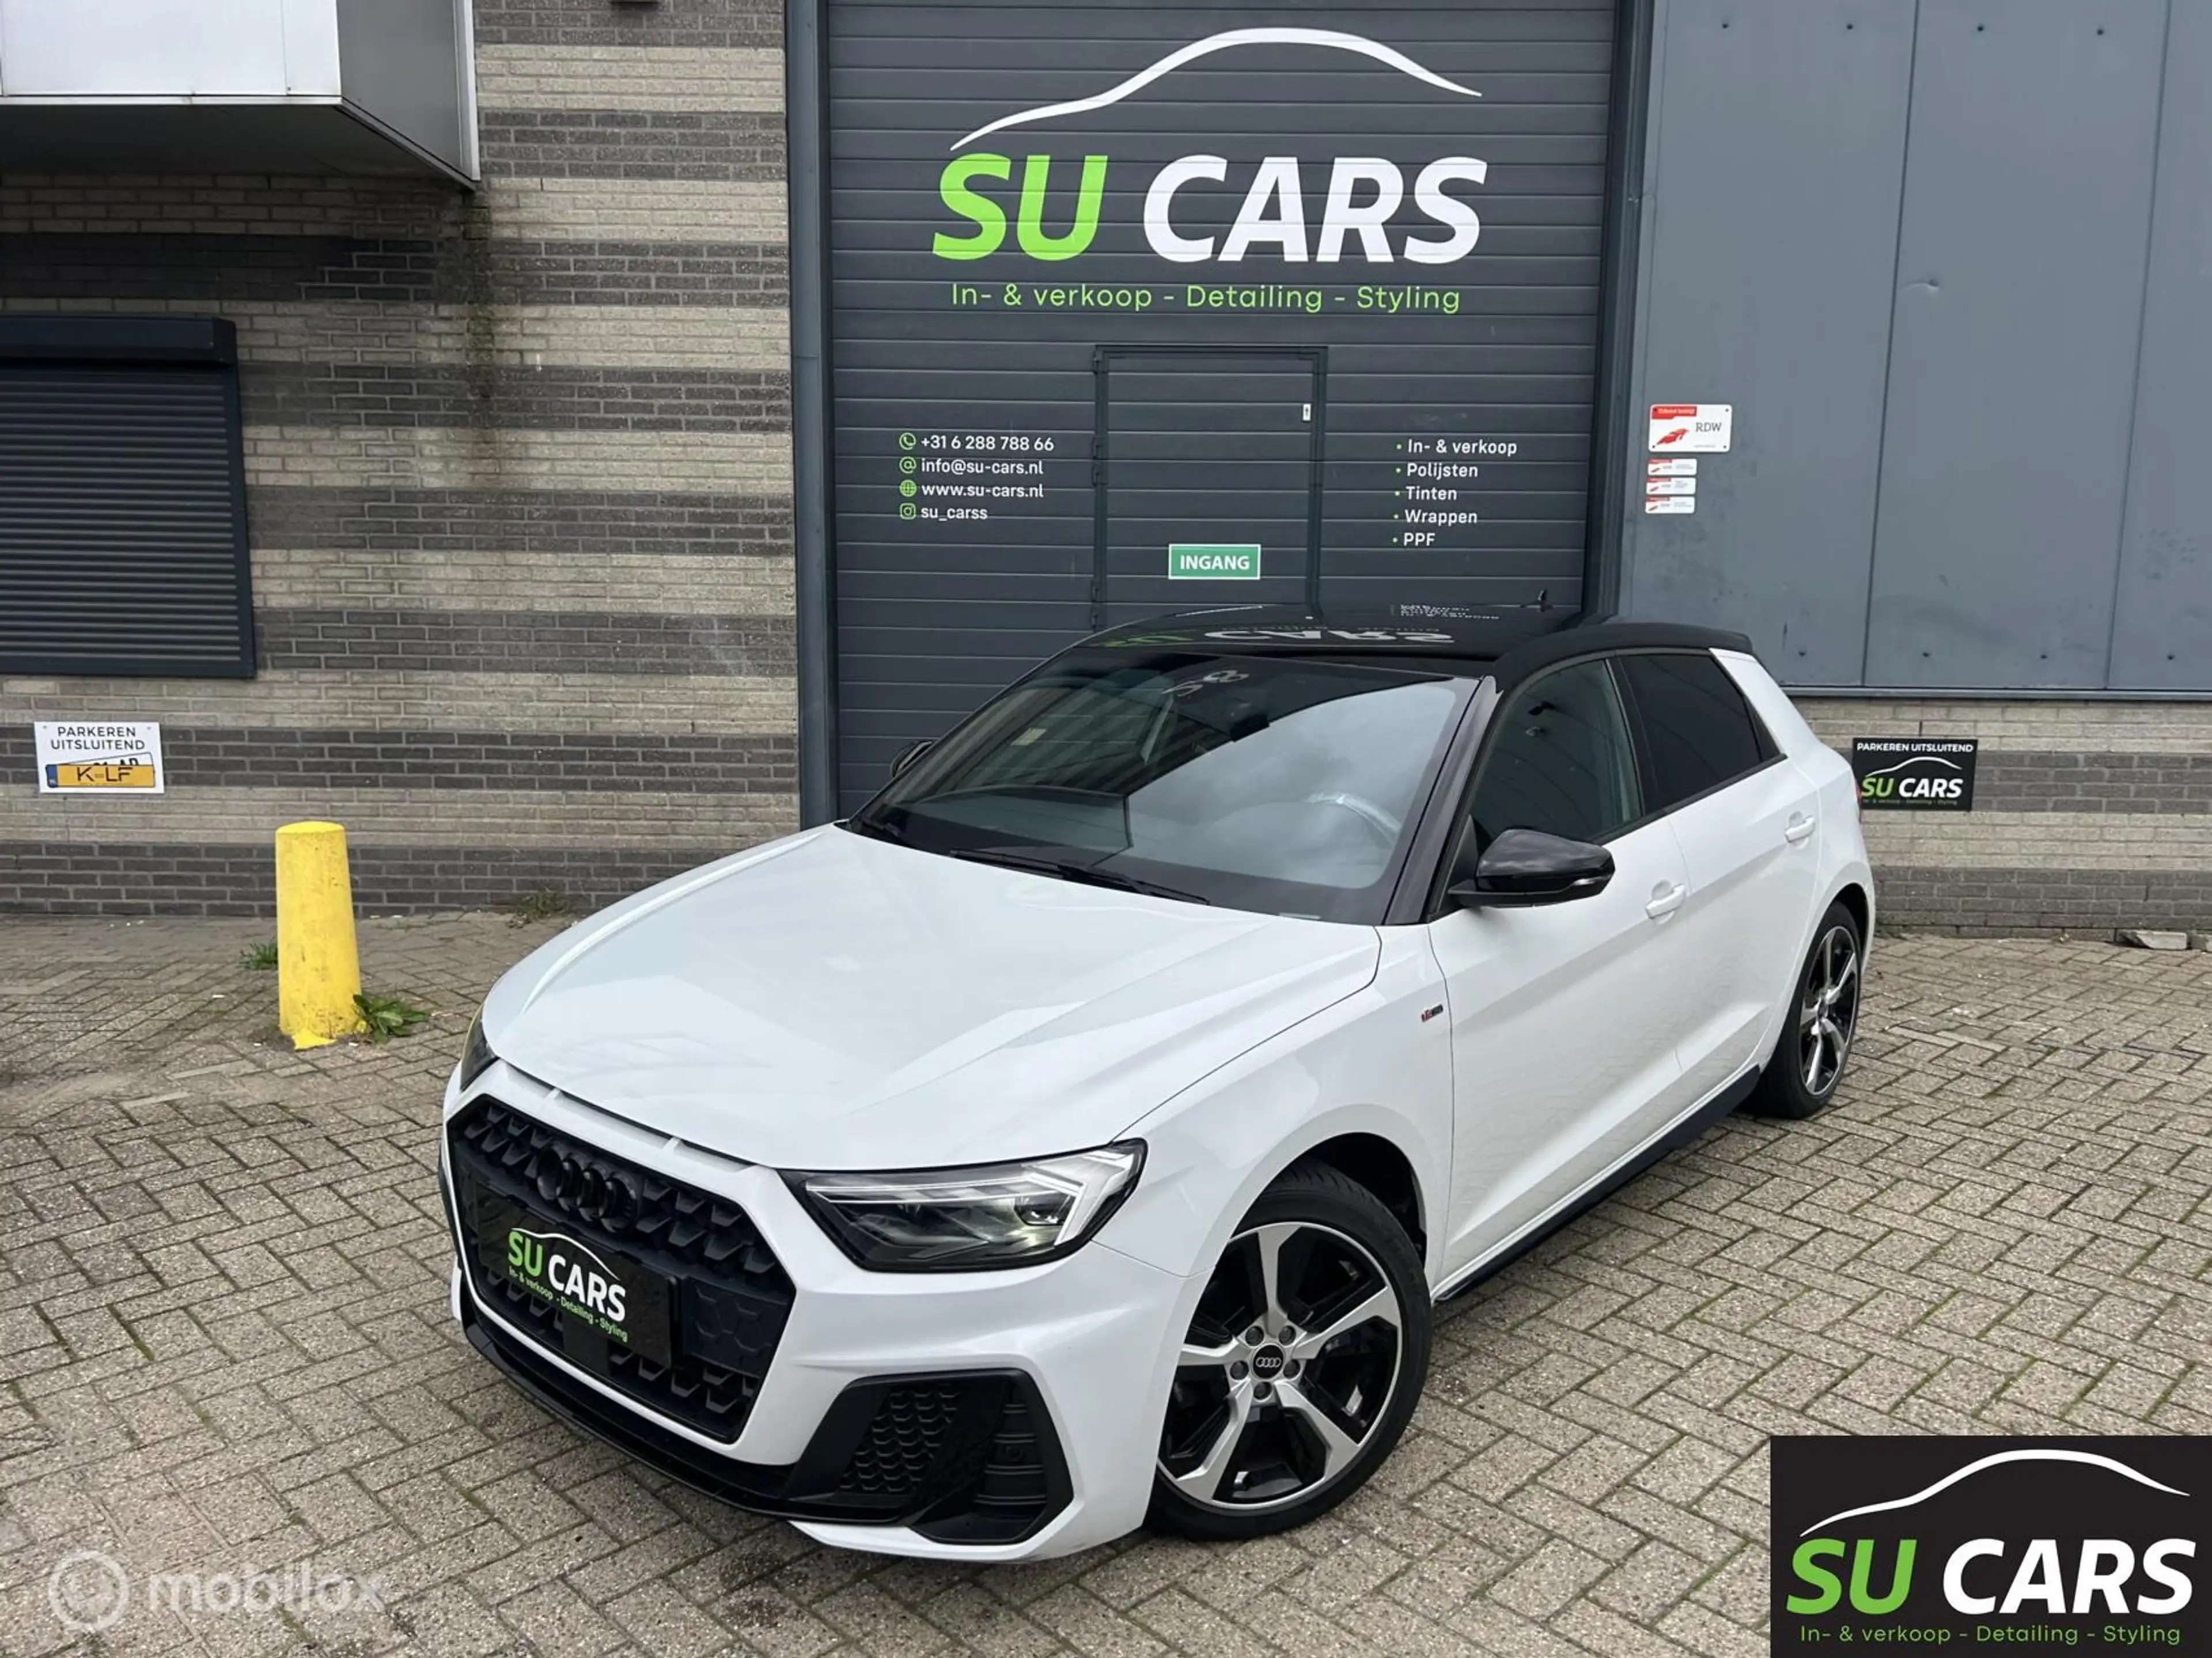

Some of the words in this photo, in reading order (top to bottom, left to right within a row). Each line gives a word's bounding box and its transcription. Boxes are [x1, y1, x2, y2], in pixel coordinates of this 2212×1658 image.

[933, 153, 1108, 260] SU
[1143, 154, 1487, 264] CARS
[952, 283, 991, 305] In-
[1003, 283, 1022, 306] &
[1033, 284, 1152, 312] verkoop
[1187, 285, 1323, 313] Detailing
[1357, 286, 1460, 314] Styling
[1695, 422, 1722, 432] RDW
[921, 435, 946, 449] +31
[950, 436, 961, 449] 6
[965, 436, 995, 450] 288
[1000, 437, 1030, 451] 788
[1033, 438, 1055, 452] 66
[1408, 439, 1430, 453] In-
[1435, 439, 1447, 454] &
[1452, 439, 1518, 457] verkoop
[922, 458, 1044, 475] info@su-cars.nl
[1407, 462, 1479, 480] Polijsten
[922, 483, 1044, 498] www.su-cars.nl
[1406, 485, 1457, 500] Tinten
[921, 507, 988, 521] su_carss
[1404, 509, 1478, 526] Wrappen
[1403, 532, 1435, 547] PPF
[1180, 555, 1250, 570] INGANG
[57, 726, 136, 737] PARKEREN
[51, 739, 146, 750] UITSLUITEND
[1857, 742, 1909, 752] PARKEREN
[1911, 743, 1974, 753] UITSLUITEND
[1861, 777, 1894, 798] SU
[1899, 777, 1963, 798] CARS
[508, 1231, 543, 1277] SU
[548, 1254, 626, 1322] CARS
